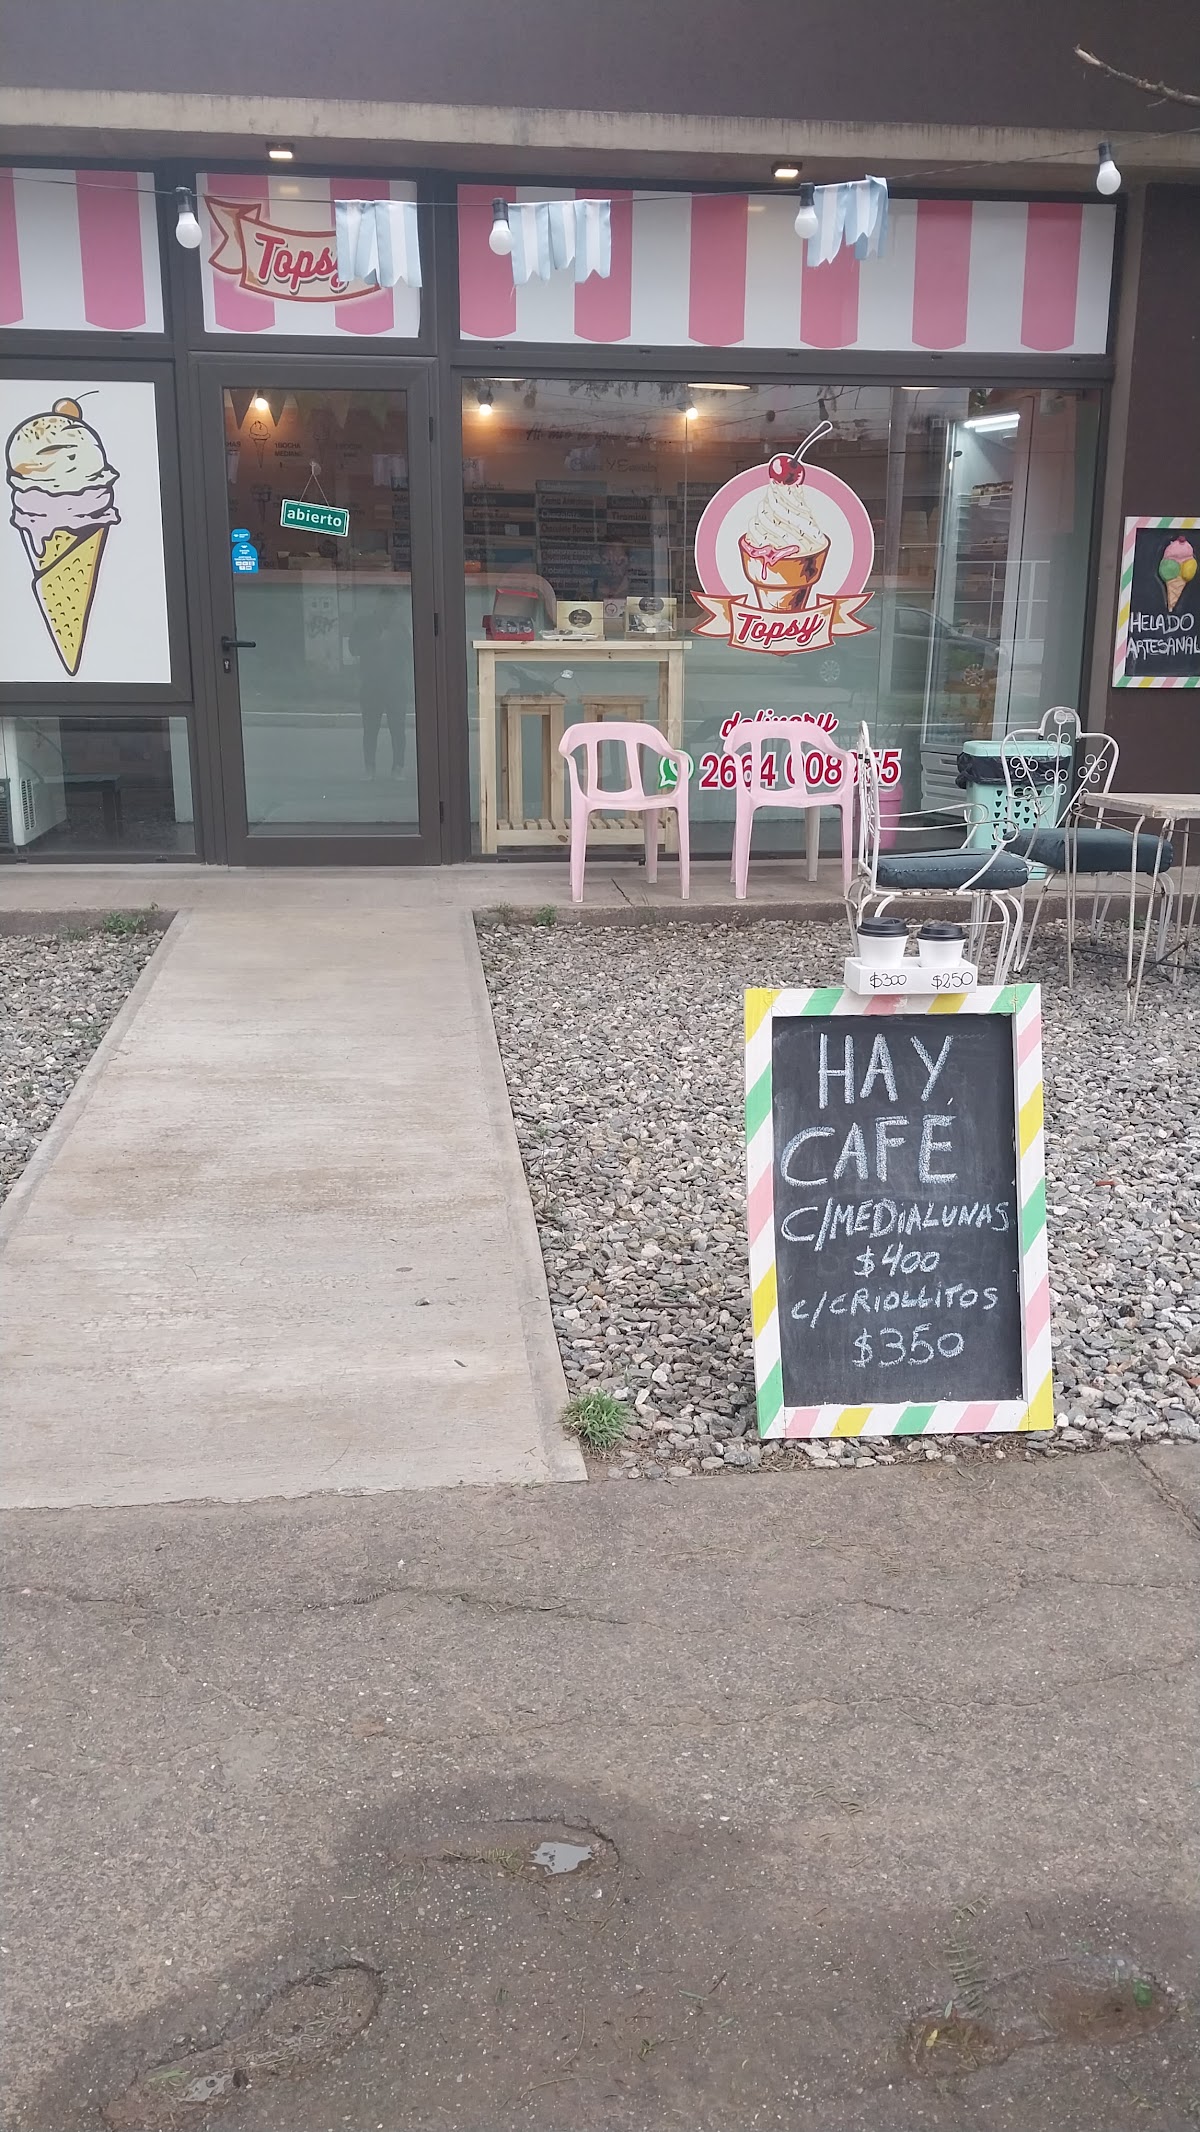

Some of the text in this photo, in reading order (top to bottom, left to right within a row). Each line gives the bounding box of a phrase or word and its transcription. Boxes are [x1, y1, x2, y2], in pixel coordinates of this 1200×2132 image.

[255, 232, 347, 294] Tops
[287, 508, 342, 527] abierto
[737, 612, 826, 648] Topsy
[1130, 611, 1195, 634] HELADO
[1126, 635, 1200, 660] ARTESANAL
[869, 971, 974, 990] $300 $250
[818, 1033, 954, 1109] HAY
[854, 1243, 940, 1278] $400
[852, 1322, 965, 1368] $350
